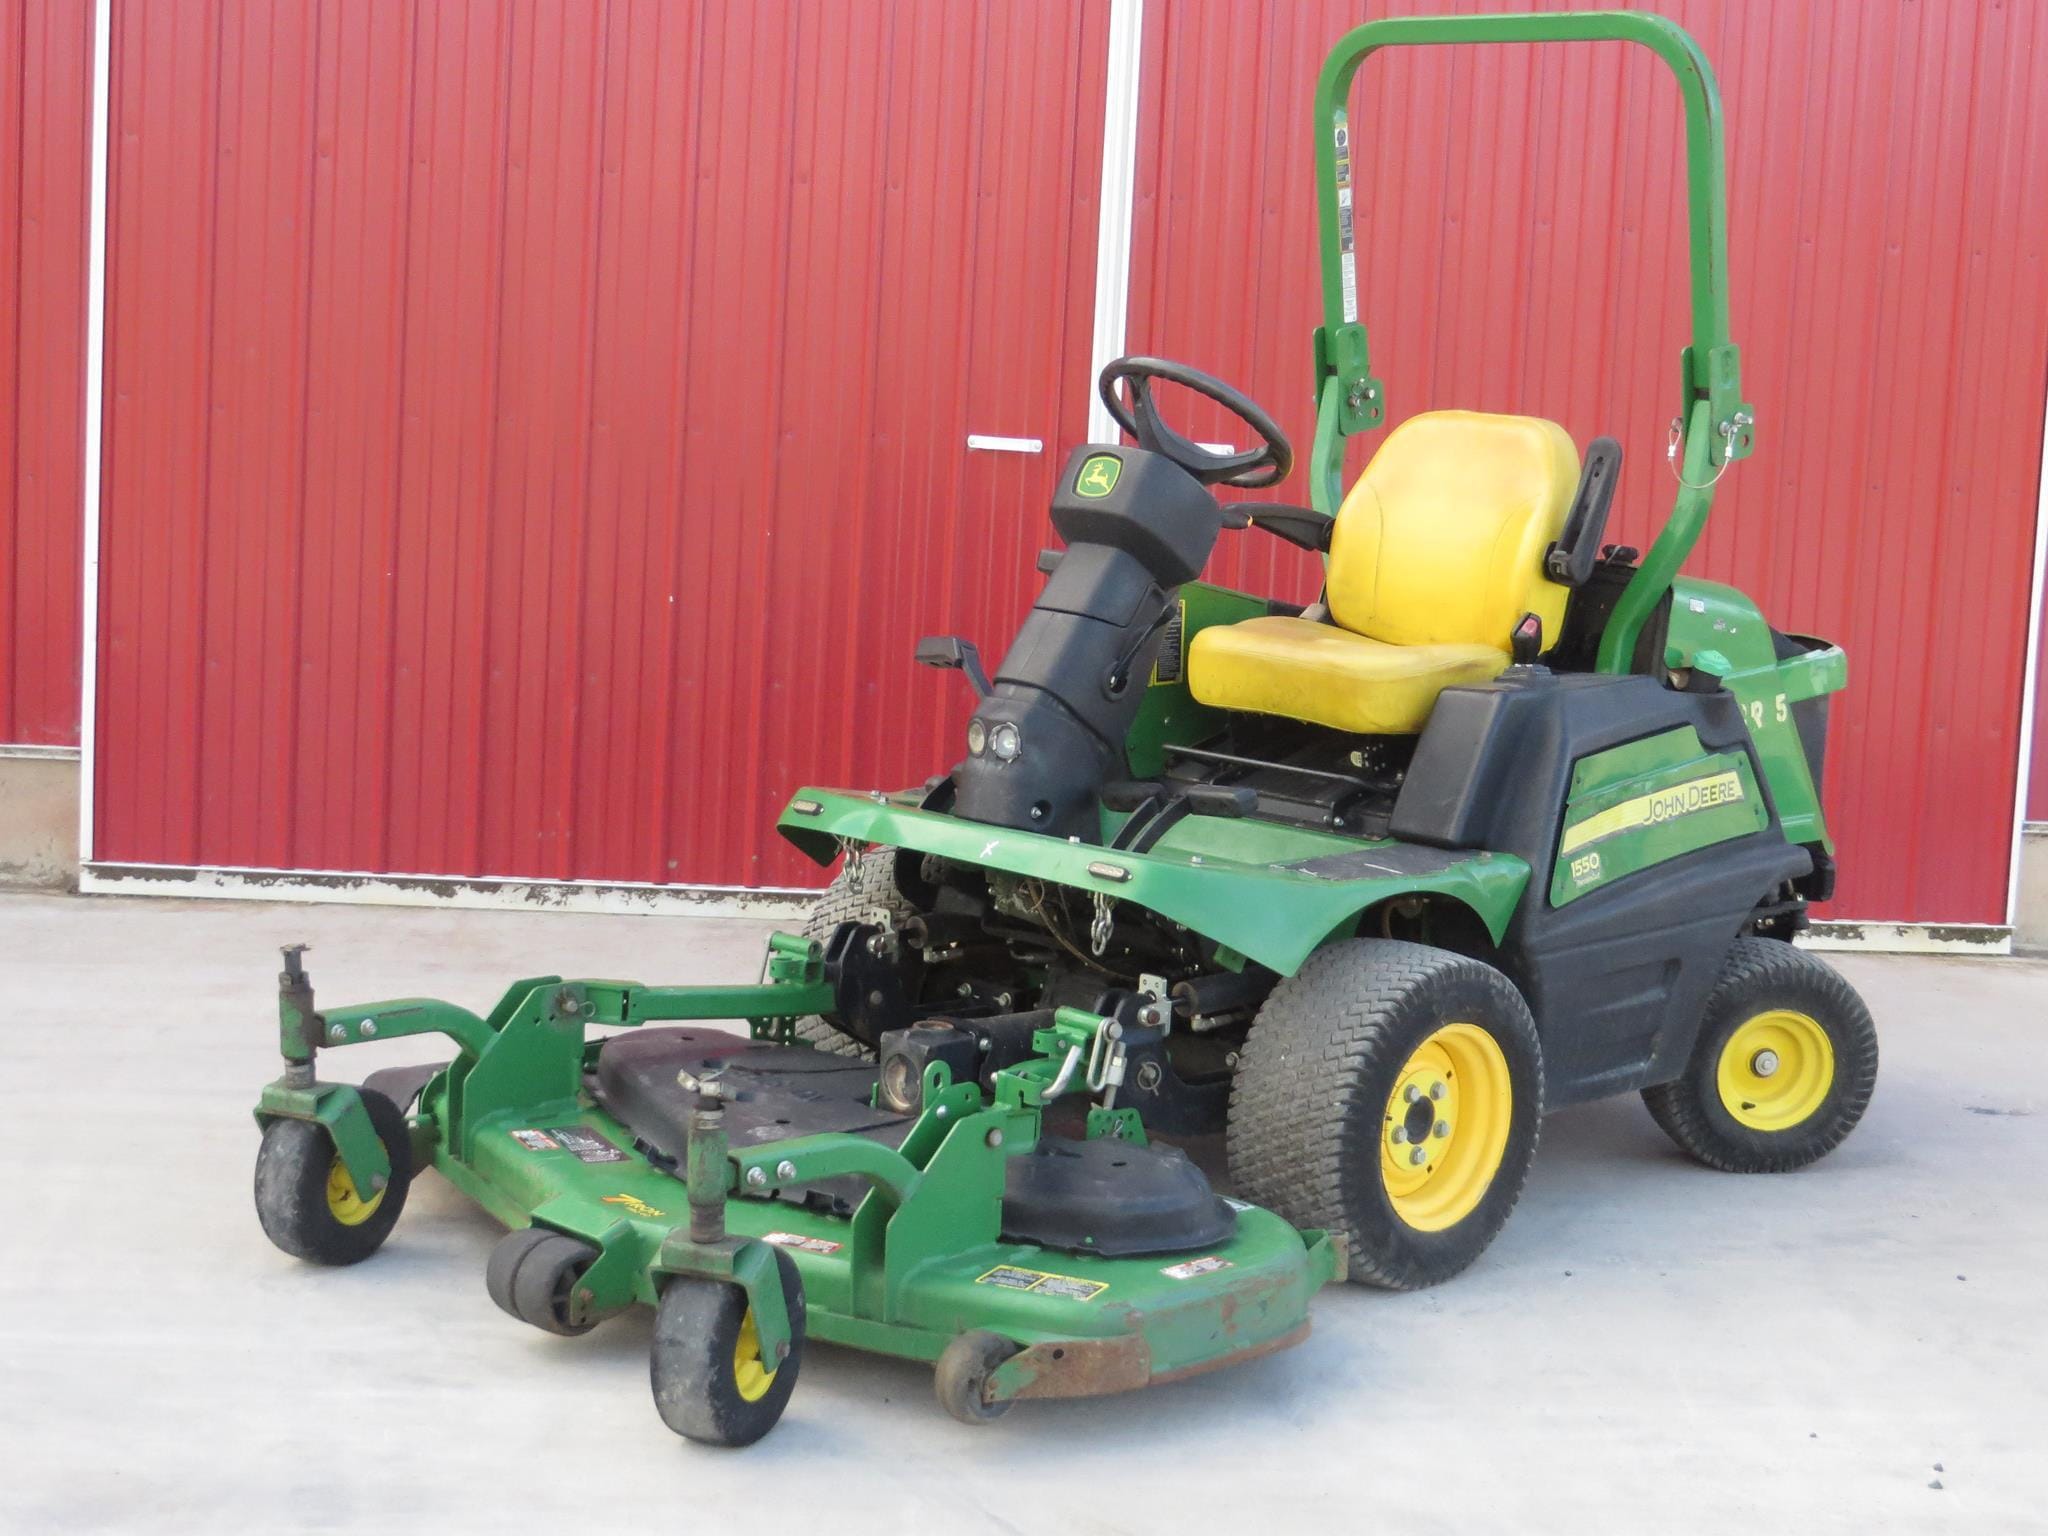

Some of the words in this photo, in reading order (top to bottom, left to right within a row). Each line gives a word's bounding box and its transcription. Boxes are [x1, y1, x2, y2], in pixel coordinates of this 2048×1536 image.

[1776, 693, 1788, 722] 5
[1643, 793, 1685, 823] JOHN
[1689, 780, 1736, 808] DEERE
[1570, 852, 1599, 878] 1550
